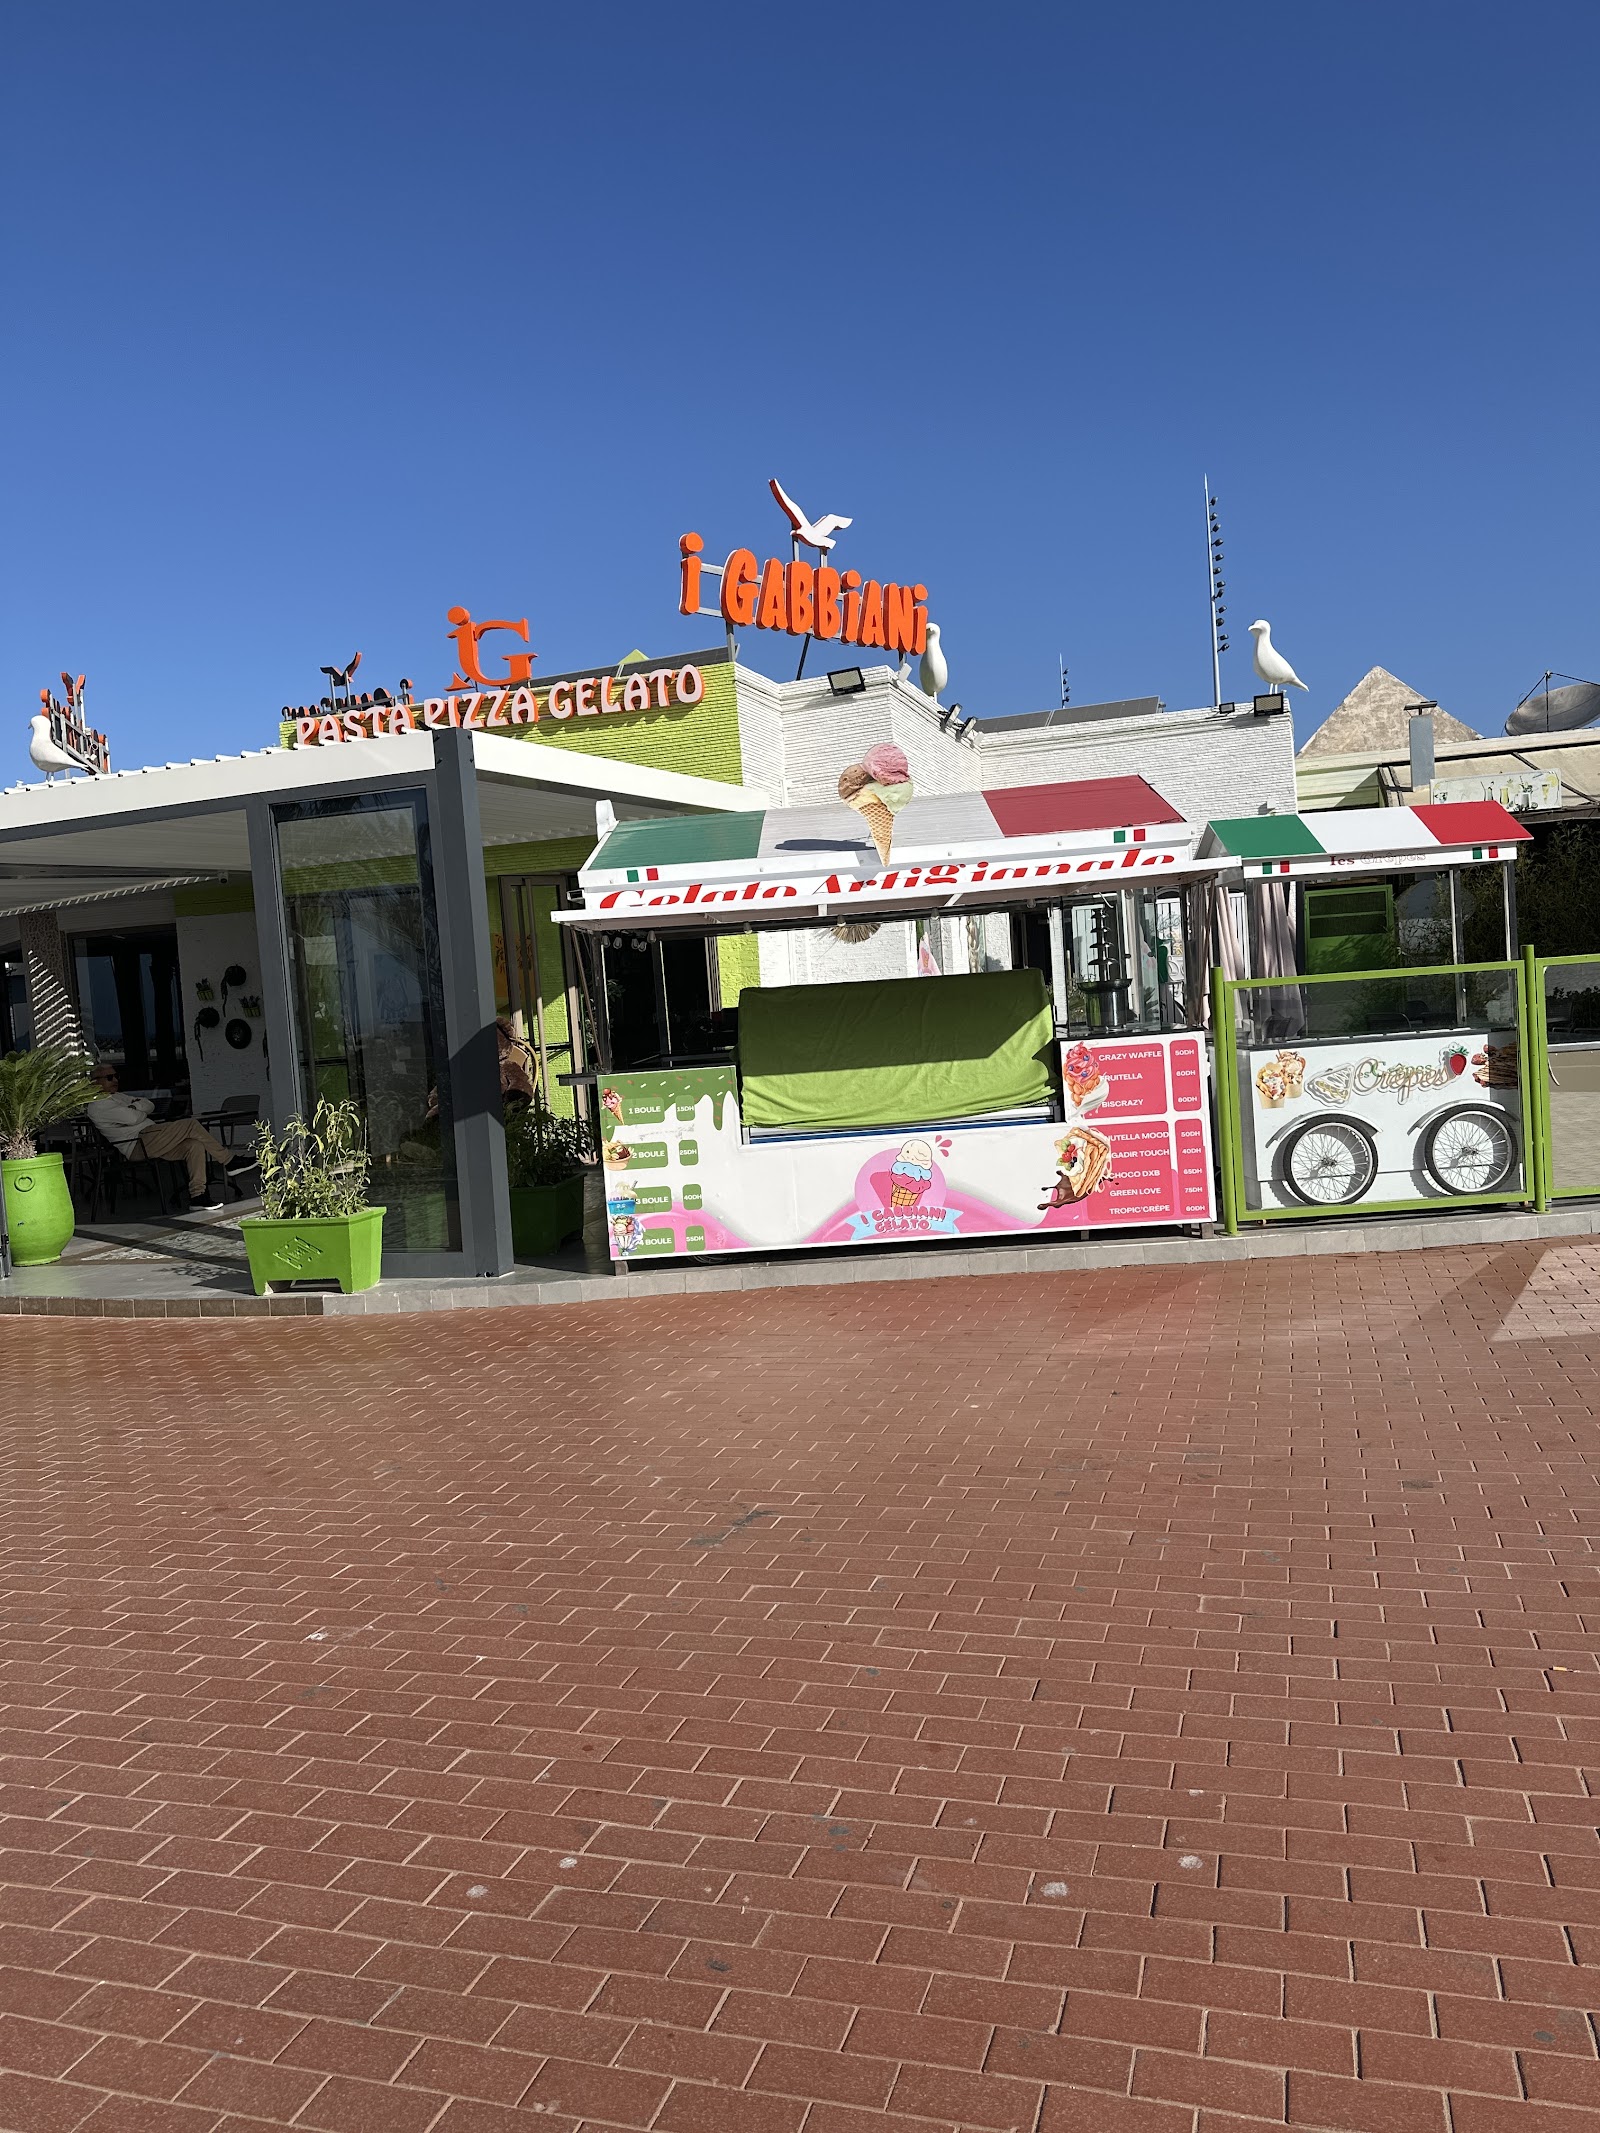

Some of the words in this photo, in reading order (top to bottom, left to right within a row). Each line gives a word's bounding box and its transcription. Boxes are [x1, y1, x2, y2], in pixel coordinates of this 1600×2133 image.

[679, 532, 704, 615] i
[296, 703, 415, 745] PASTA
[424, 687, 539, 728] PIZZA
[548, 664, 705, 719] GELATO
[1098, 1053, 1127, 1061] CRAZY
[1128, 1050, 1163, 1059] WAFFLE
[1100, 1072, 1143, 1081] FRUITELLA
[1101, 1099, 1144, 1108] BISCRAZY
[635, 1106, 662, 1114] BOULE
[1141, 1131, 1169, 1139] MOOD
[639, 1150, 666, 1159] BOULE
[1139, 1149, 1170, 1157] TOUCH
[1109, 1171, 1141, 1179] CHOCO
[1142, 1169, 1160, 1177] DXB
[1109, 1189, 1138, 1197] GREEN
[1139, 1187, 1161, 1195] LOVE
[875, 1219, 932, 1233] GELATO
[645, 1238, 673, 1246] BOULE
